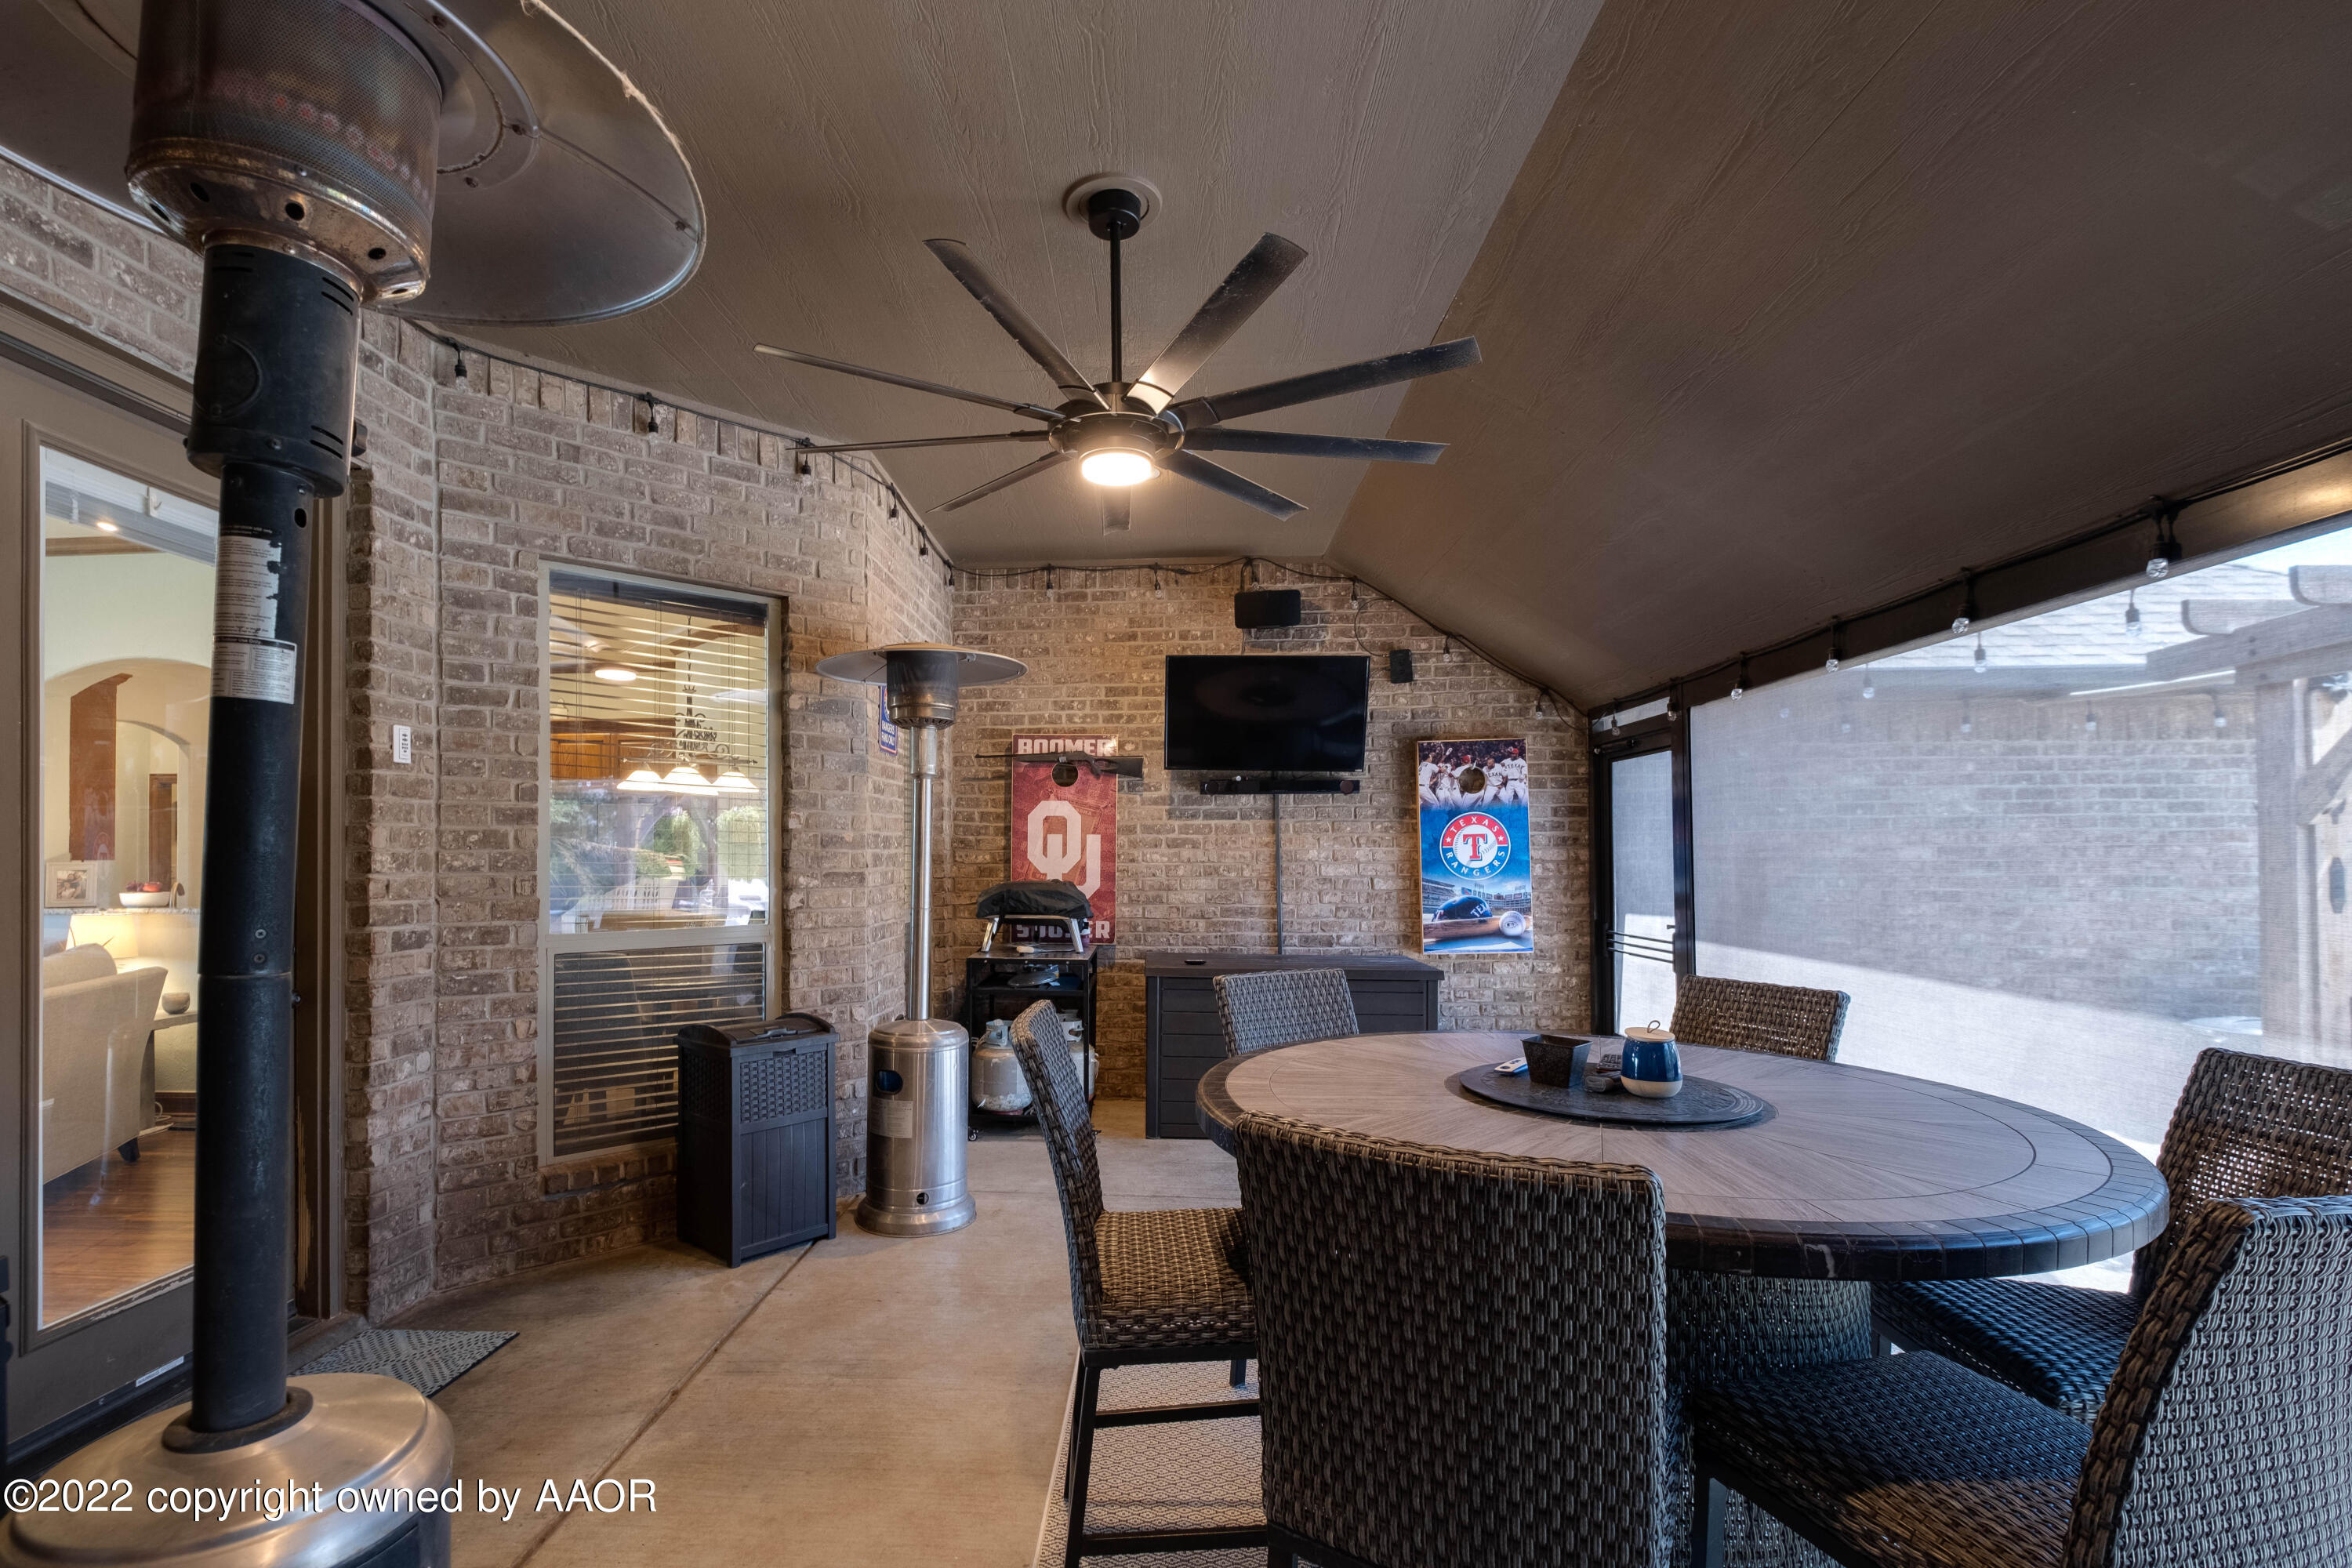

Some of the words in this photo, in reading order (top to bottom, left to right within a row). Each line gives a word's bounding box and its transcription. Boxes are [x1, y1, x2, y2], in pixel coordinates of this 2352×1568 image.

[1450, 816, 1499, 834] TEXAS
[1462, 833, 1487, 861] T
[1446, 851, 1505, 877] RANGERS
[1017, 921, 1110, 938] SOR
